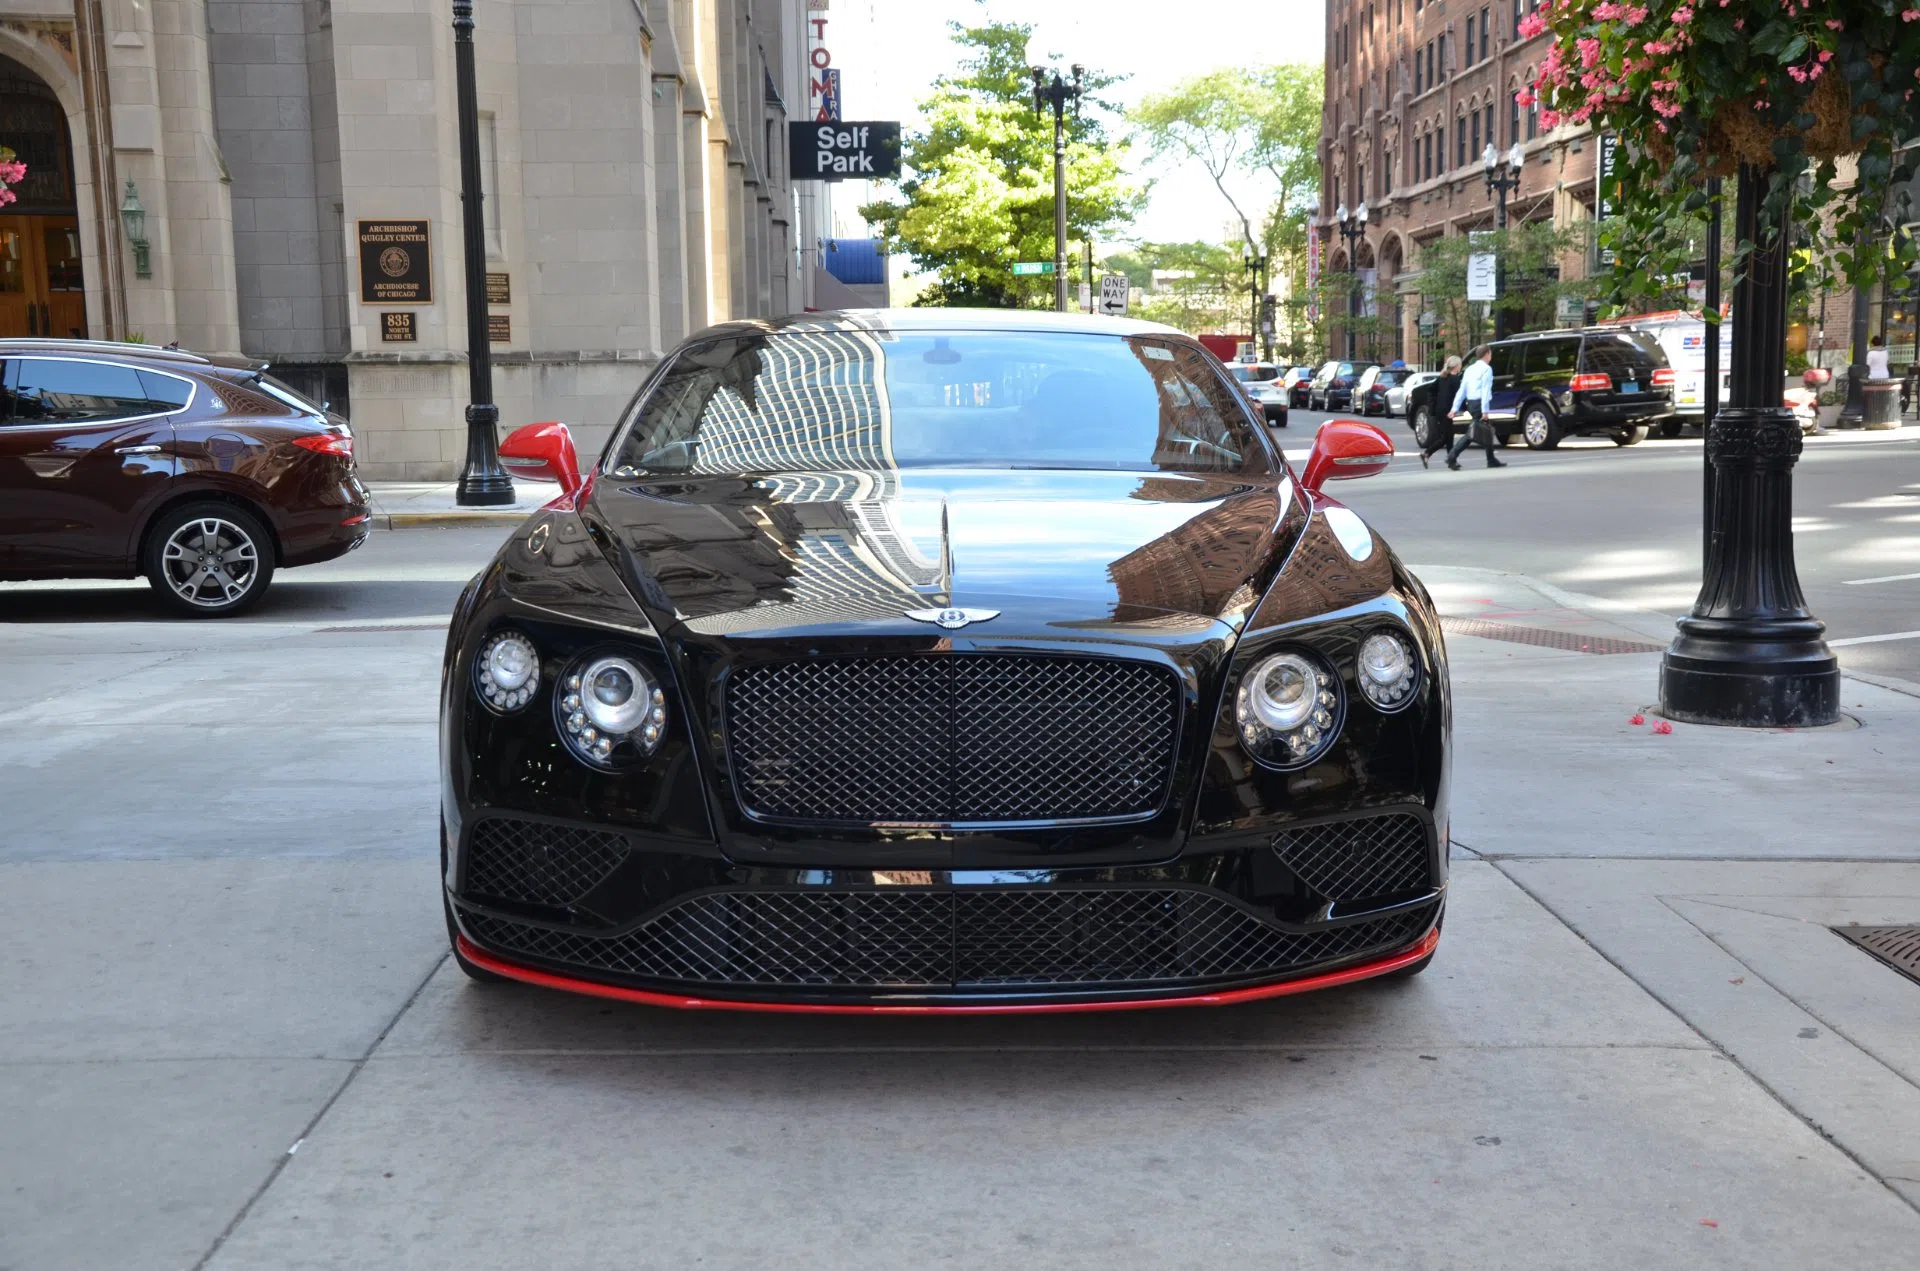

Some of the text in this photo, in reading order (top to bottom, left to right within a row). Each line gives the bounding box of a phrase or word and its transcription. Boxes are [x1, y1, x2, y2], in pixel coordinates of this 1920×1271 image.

[817, 126, 869, 149] Self
[817, 150, 874, 173] Park
[368, 225, 418, 233] ARCHBISHOP
[361, 234, 426, 243] QUIGLEY CENTER
[1104, 277, 1126, 288] ONE
[387, 290, 416, 298] CHICAGO
[1103, 289, 1126, 299] WAY
[387, 314, 410, 327] 835
